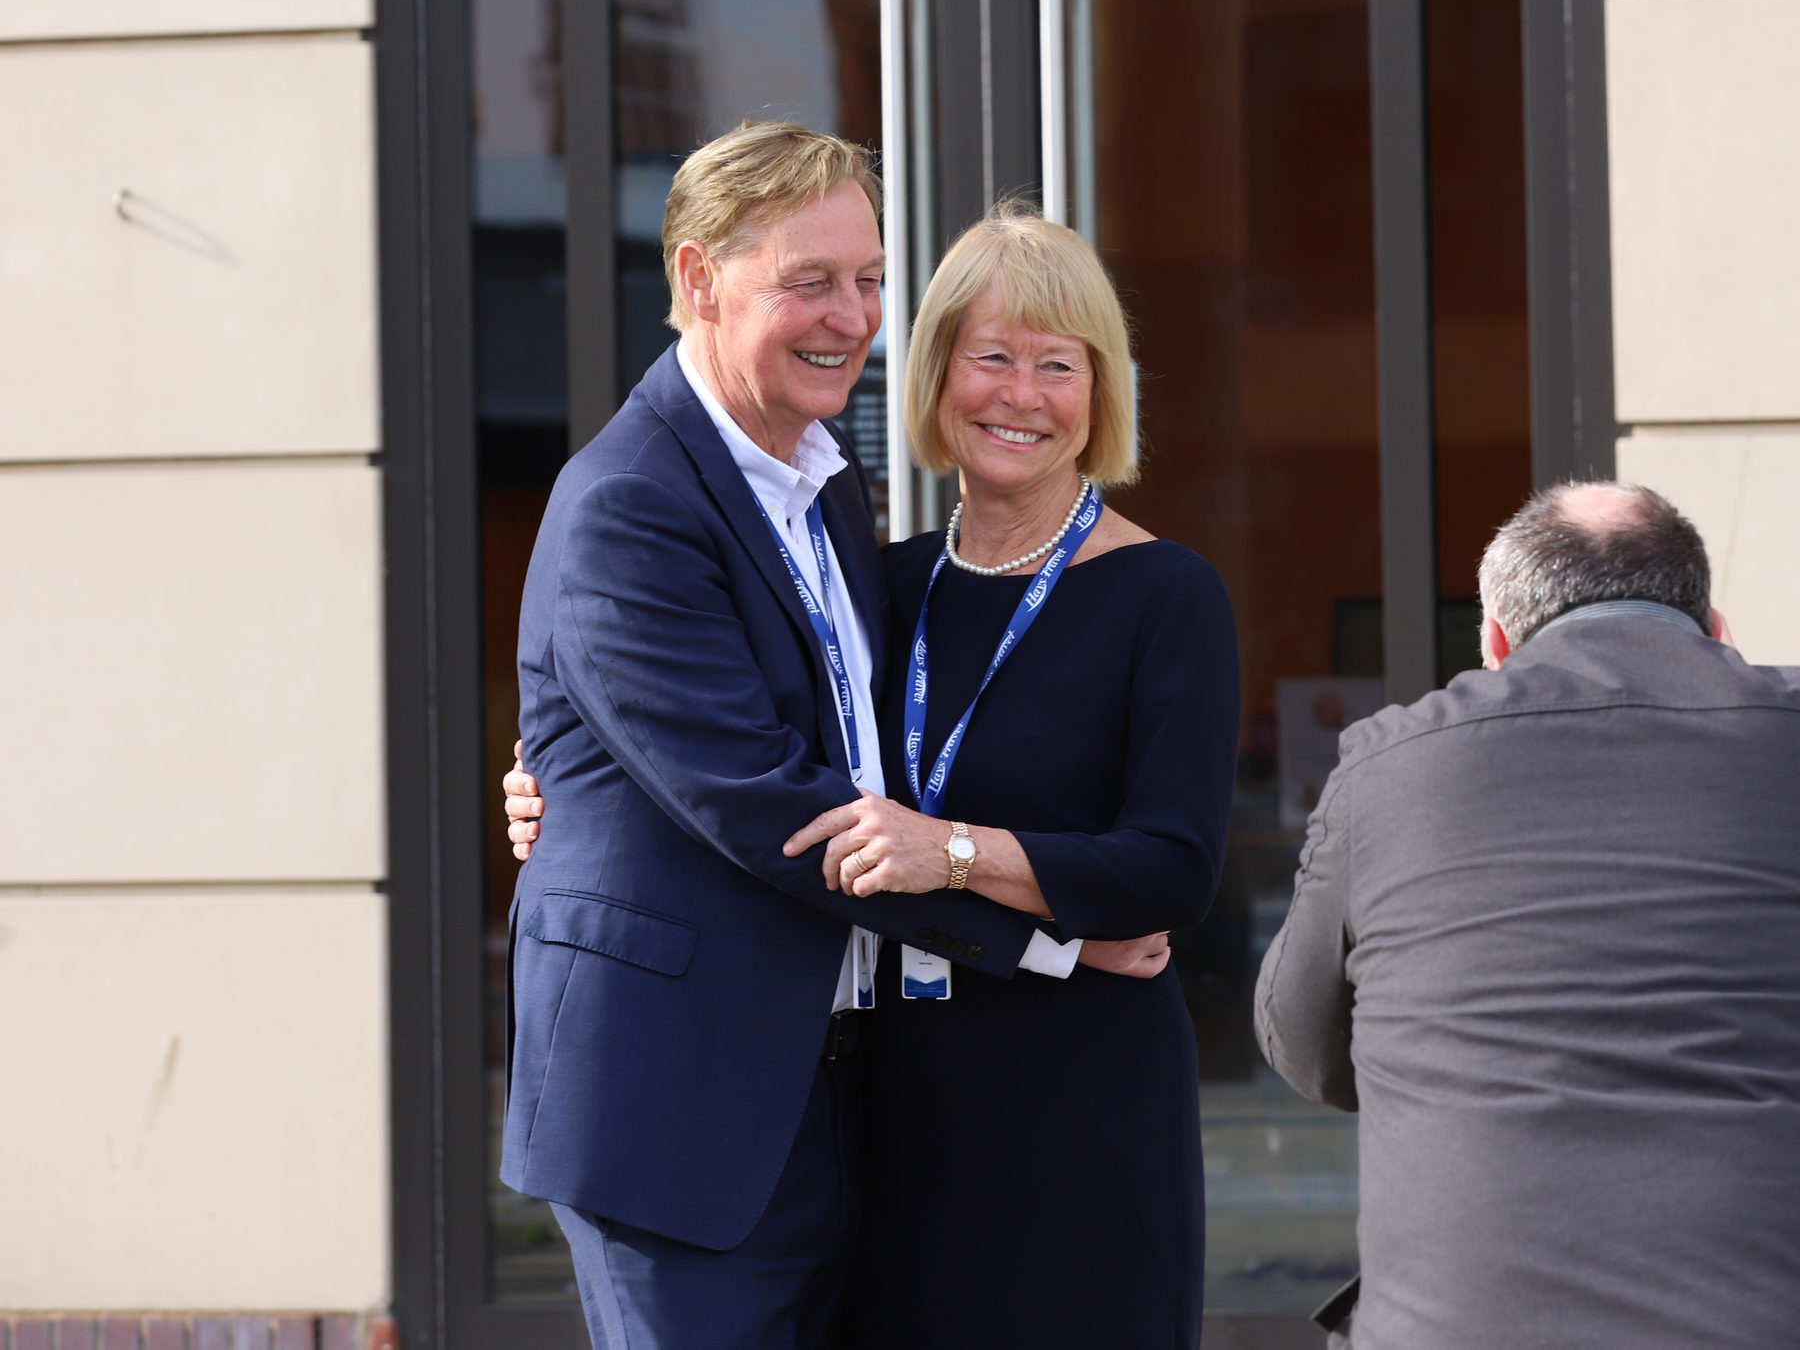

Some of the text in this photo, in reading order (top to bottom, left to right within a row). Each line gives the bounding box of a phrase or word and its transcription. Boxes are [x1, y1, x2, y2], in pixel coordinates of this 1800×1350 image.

[1075, 503, 1097, 533] Hays
[794, 576, 821, 616] Travel
[1025, 546, 1068, 613] Hays Travel
[826, 643, 852, 719] Hays Travel
[913, 668, 927, 706] Travel
[908, 730, 921, 760] Hays
[928, 722, 964, 798] Hays Travel
